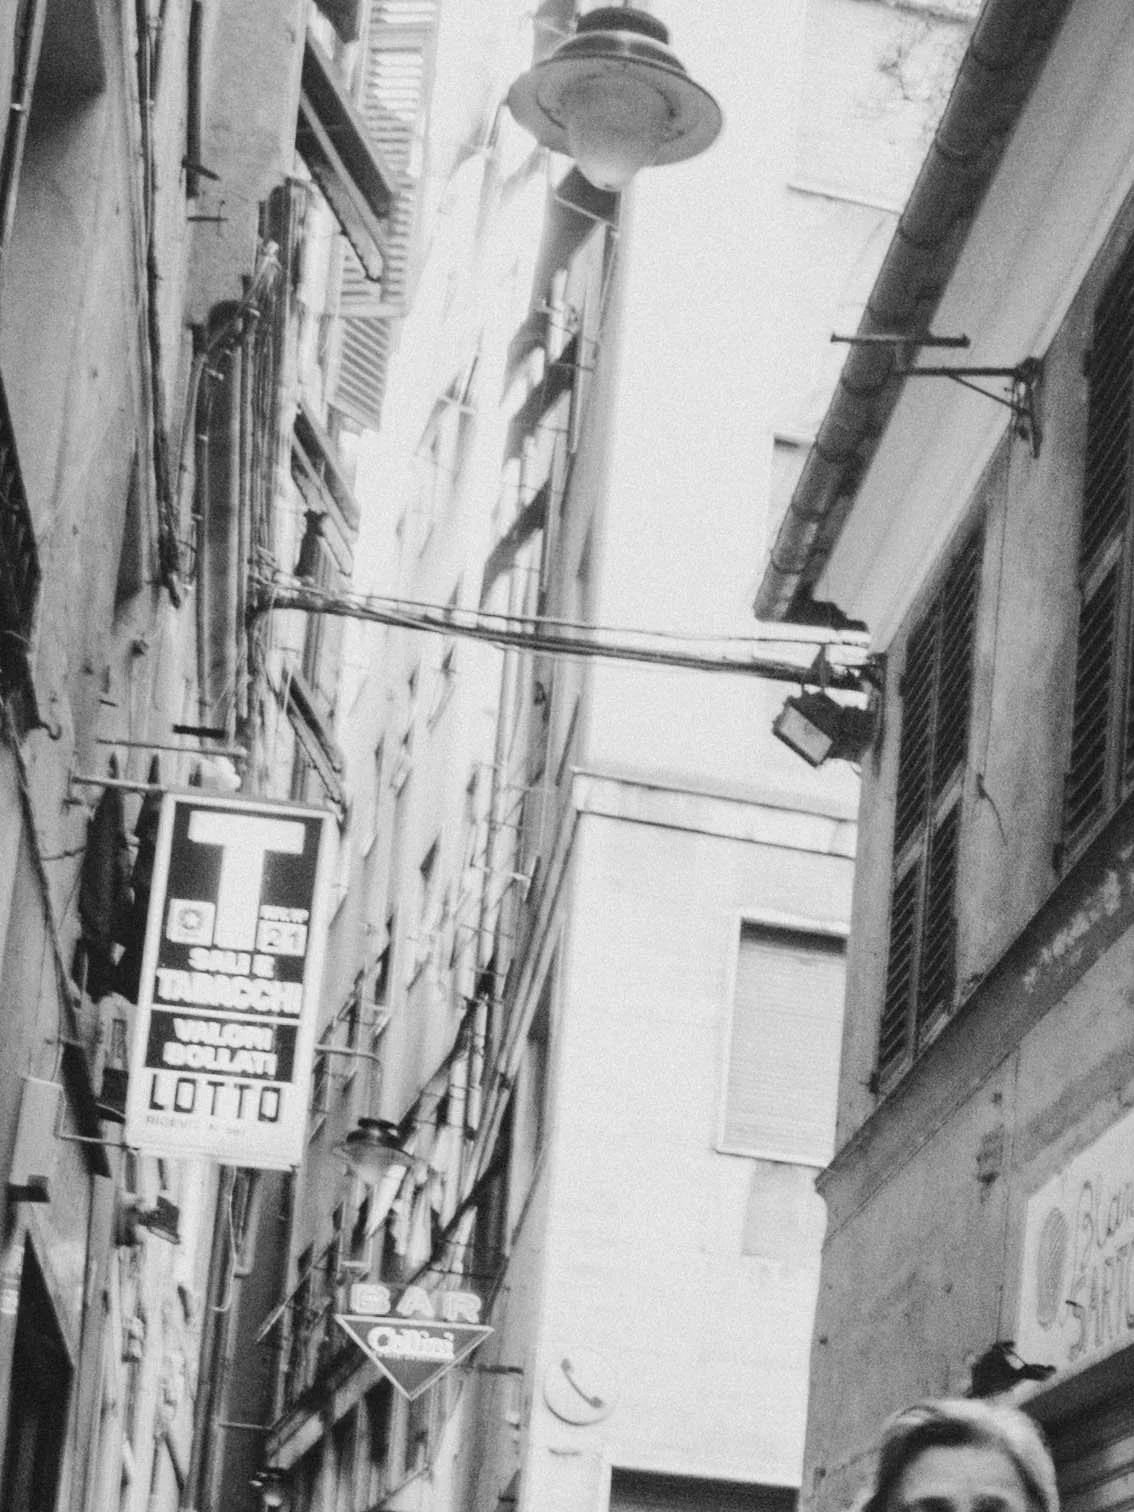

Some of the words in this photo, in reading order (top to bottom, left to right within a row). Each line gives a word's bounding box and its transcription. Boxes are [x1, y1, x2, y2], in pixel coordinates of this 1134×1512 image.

[188, 946, 251, 976] SALI
[252, 953, 276, 979] E
[156, 967, 304, 1015] TABACCHI
[172, 1017, 274, 1052] VALORI
[162, 1041, 278, 1077] BOLLATI
[148, 1073, 282, 1124] LOTTO
[350, 1282, 482, 1324] BAR
